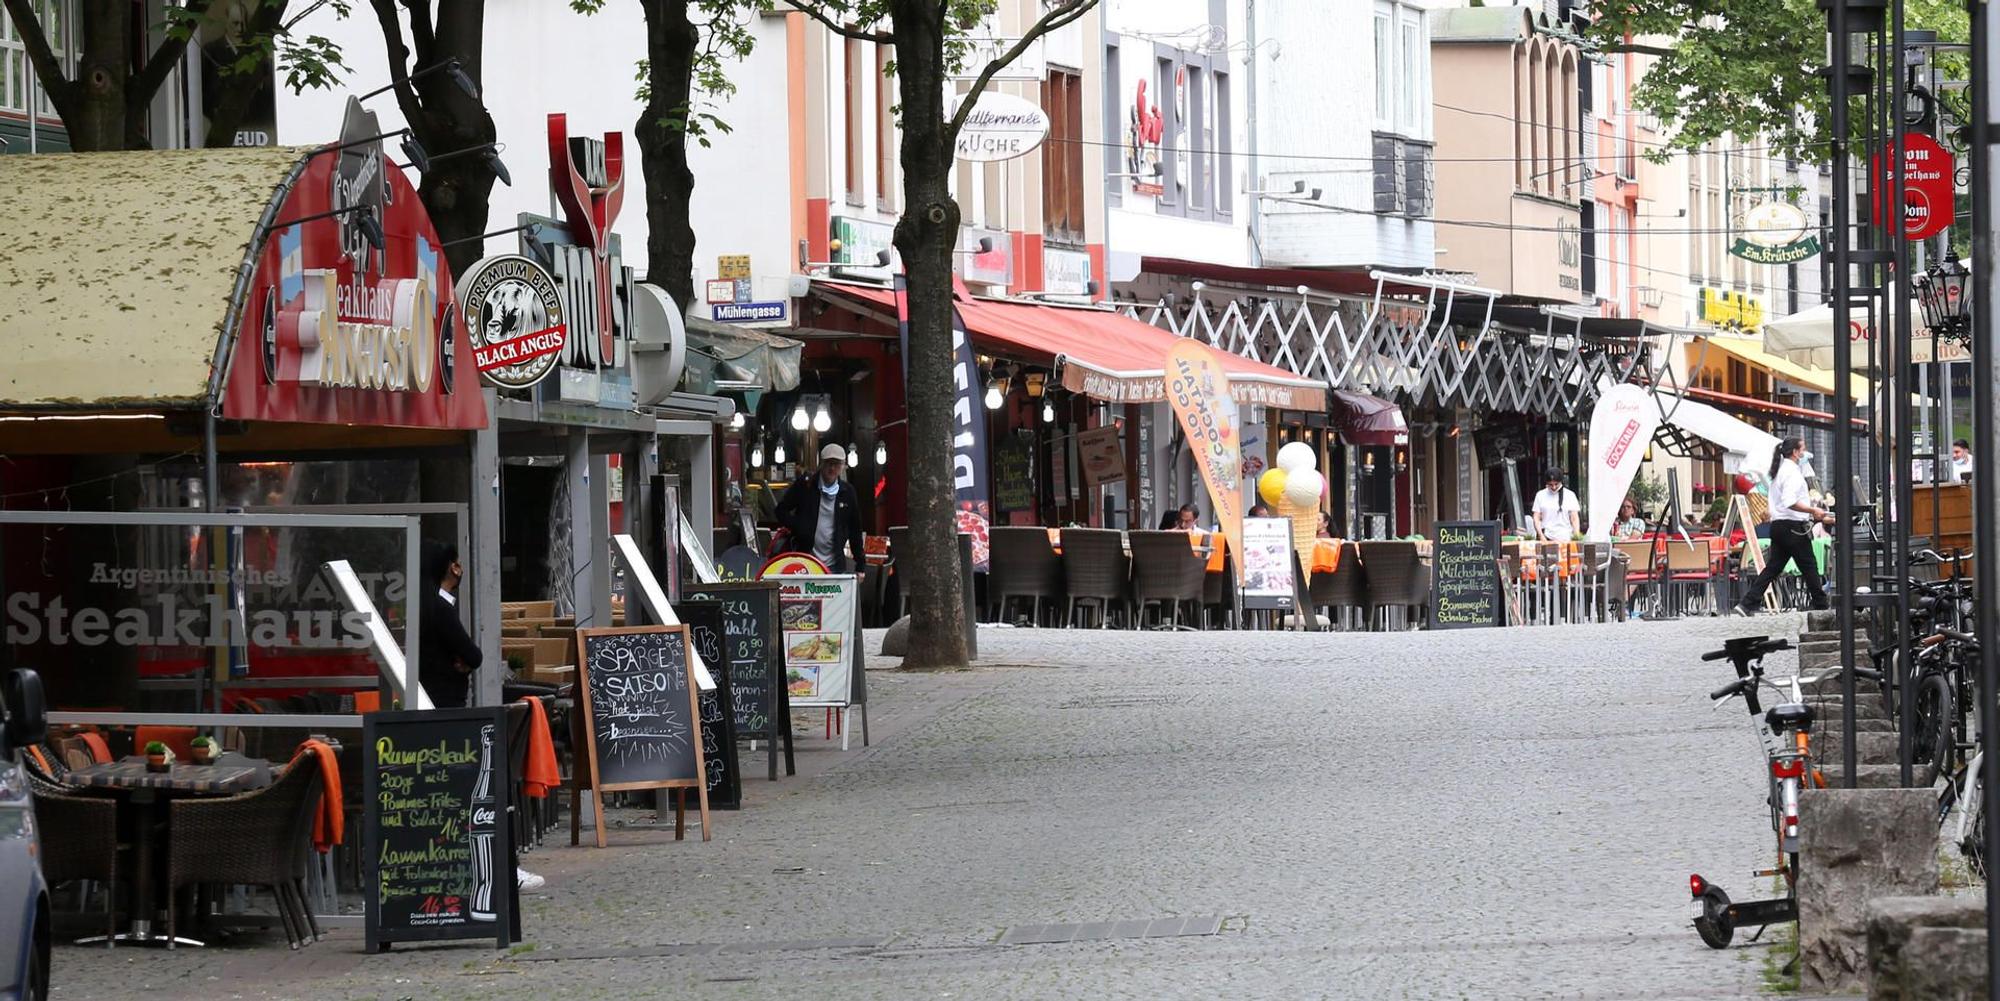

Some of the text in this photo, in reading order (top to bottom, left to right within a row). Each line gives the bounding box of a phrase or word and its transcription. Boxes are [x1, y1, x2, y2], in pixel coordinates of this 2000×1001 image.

[233, 131, 268, 146] EUD
[336, 273, 392, 320] eakhaus
[470, 262, 558, 308] PREMIUM BEEF
[717, 306, 780, 319] Mühlengasse
[475, 331, 563, 367] BLACK ANGUS
[1607, 419, 1640, 468] COCKTAILS
[90, 563, 292, 588] Argentinisches
[7, 591, 373, 649] Steakhaus
[606, 672, 680, 696] SAISON
[376, 736, 478, 774] Rumpsteak
